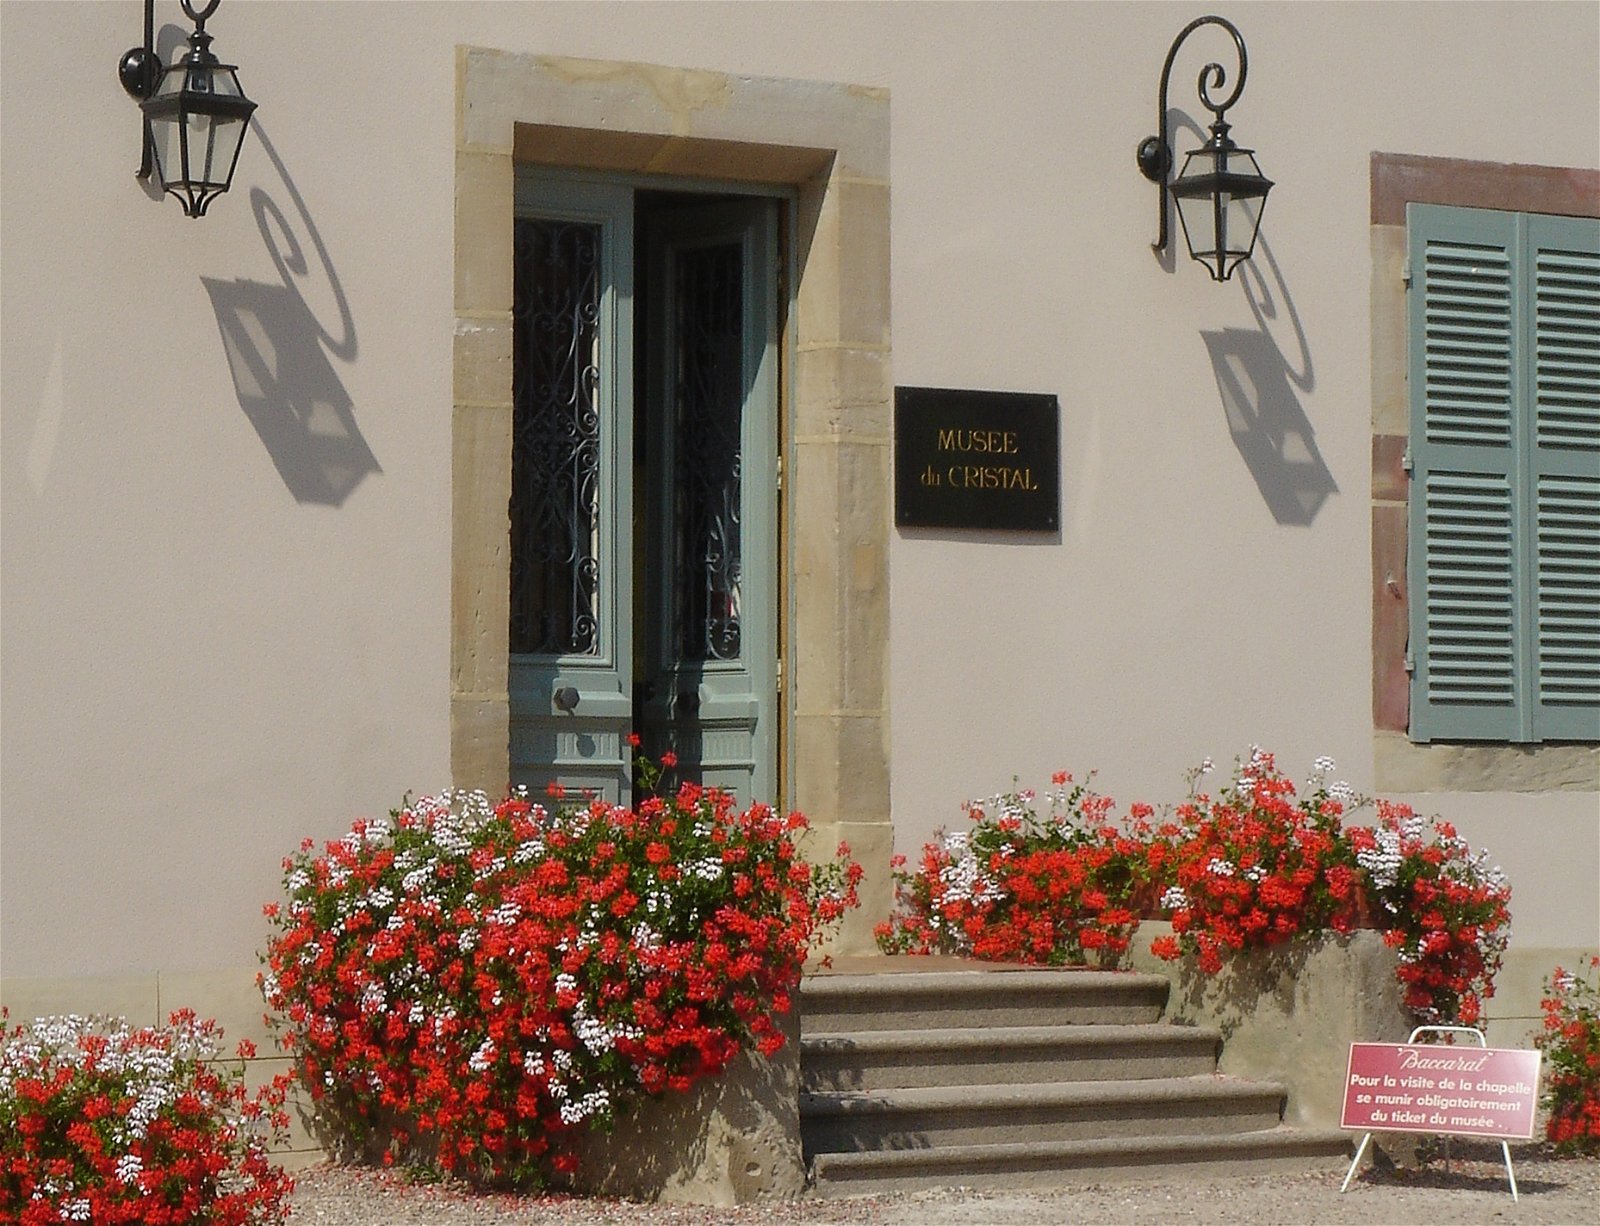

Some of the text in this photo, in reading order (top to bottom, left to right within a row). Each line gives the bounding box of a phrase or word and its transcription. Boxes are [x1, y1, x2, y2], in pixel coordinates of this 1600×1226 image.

[938, 429, 1019, 453] MUSEE
[921, 465, 1038, 490] du CRISTAL
[1398, 1049, 1489, 1072] Baccarat
[1350, 1074, 1531, 1096] Pour la visite de la chapelle
[1356, 1093, 1520, 1111] se munir obligatoirement
[1371, 1110, 1388, 1121] du
[1391, 1111, 1426, 1122] ticket
[1430, 1113, 1447, 1125] du
[1451, 1116, 1494, 1127] musée
